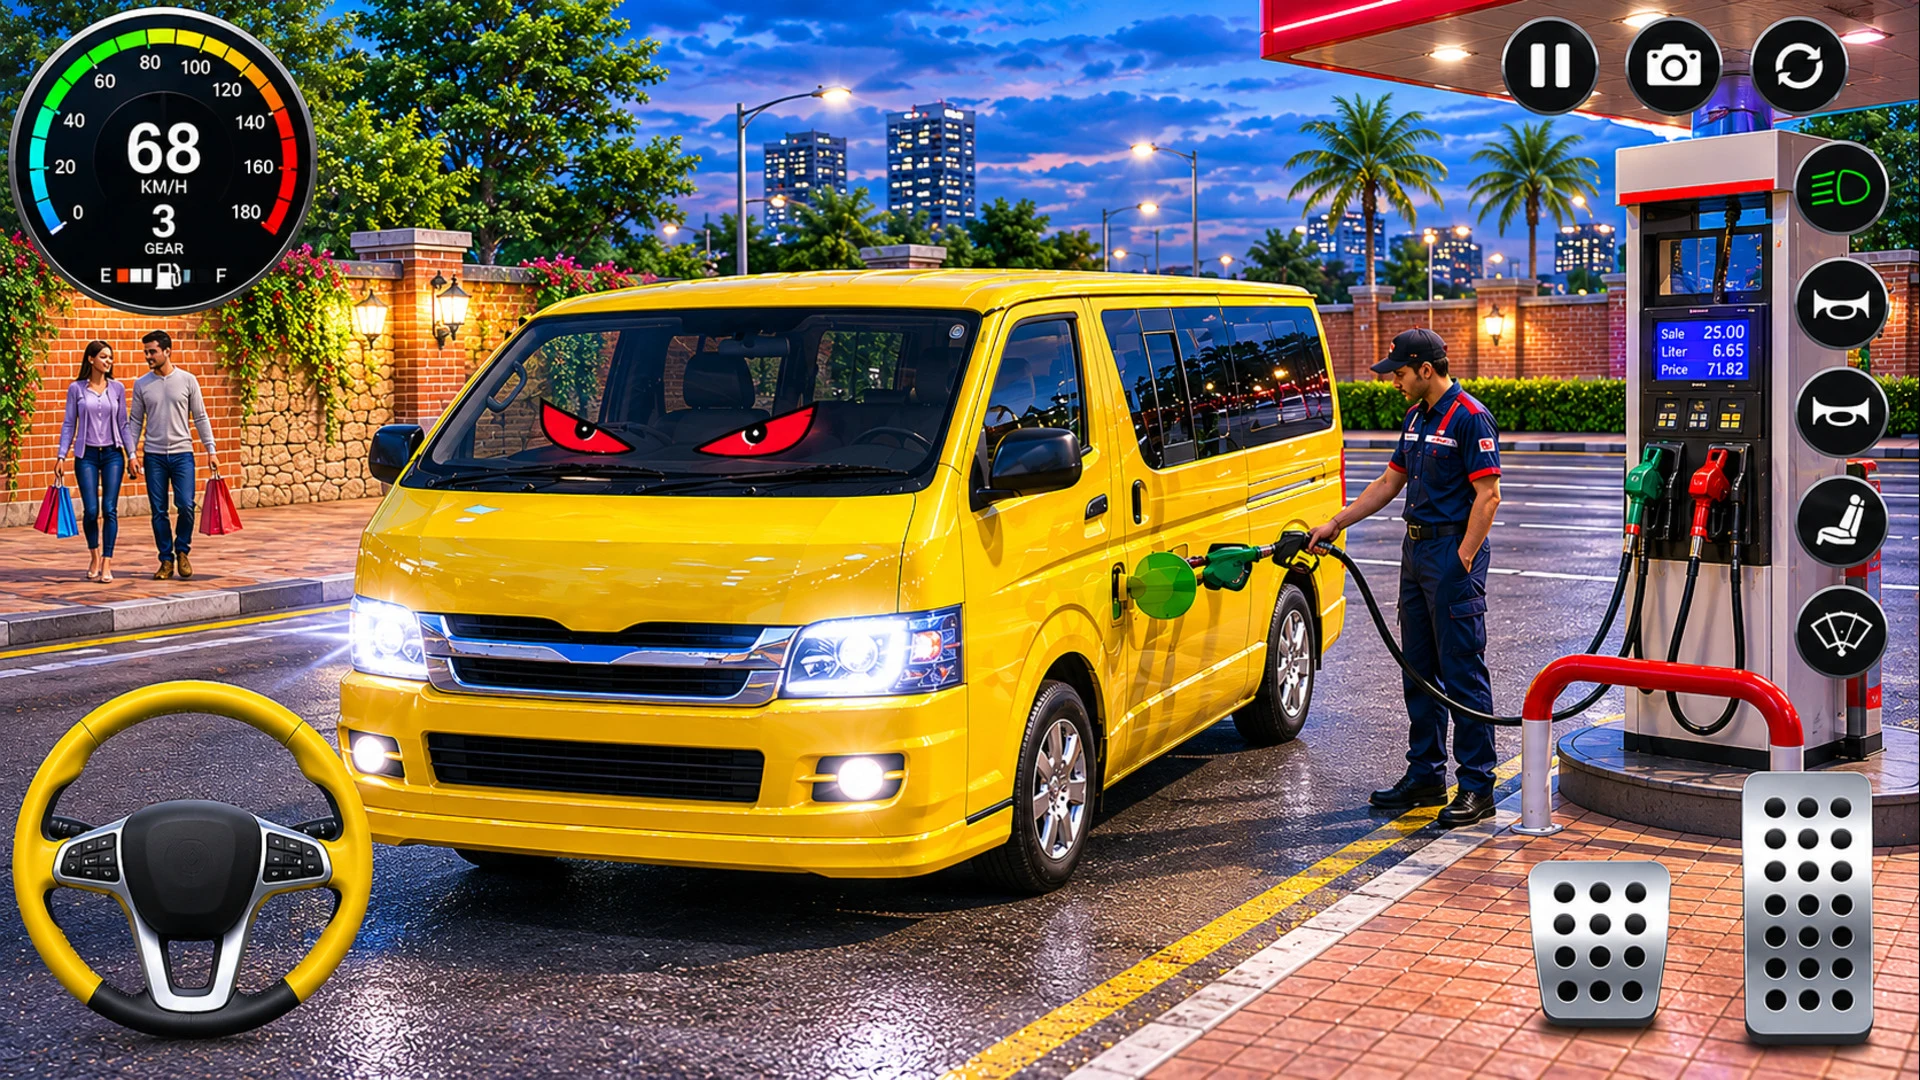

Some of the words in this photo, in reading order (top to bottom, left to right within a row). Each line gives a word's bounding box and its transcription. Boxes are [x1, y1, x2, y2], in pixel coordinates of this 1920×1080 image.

[1661, 327, 1685, 340] Sale
[1703, 324, 1745, 340] 25.00
[1661, 345, 1688, 358] Liter
[1712, 342, 1744, 358] 6.65
[1661, 363, 1689, 375] Price
[1707, 361, 1744, 376] 71.82
